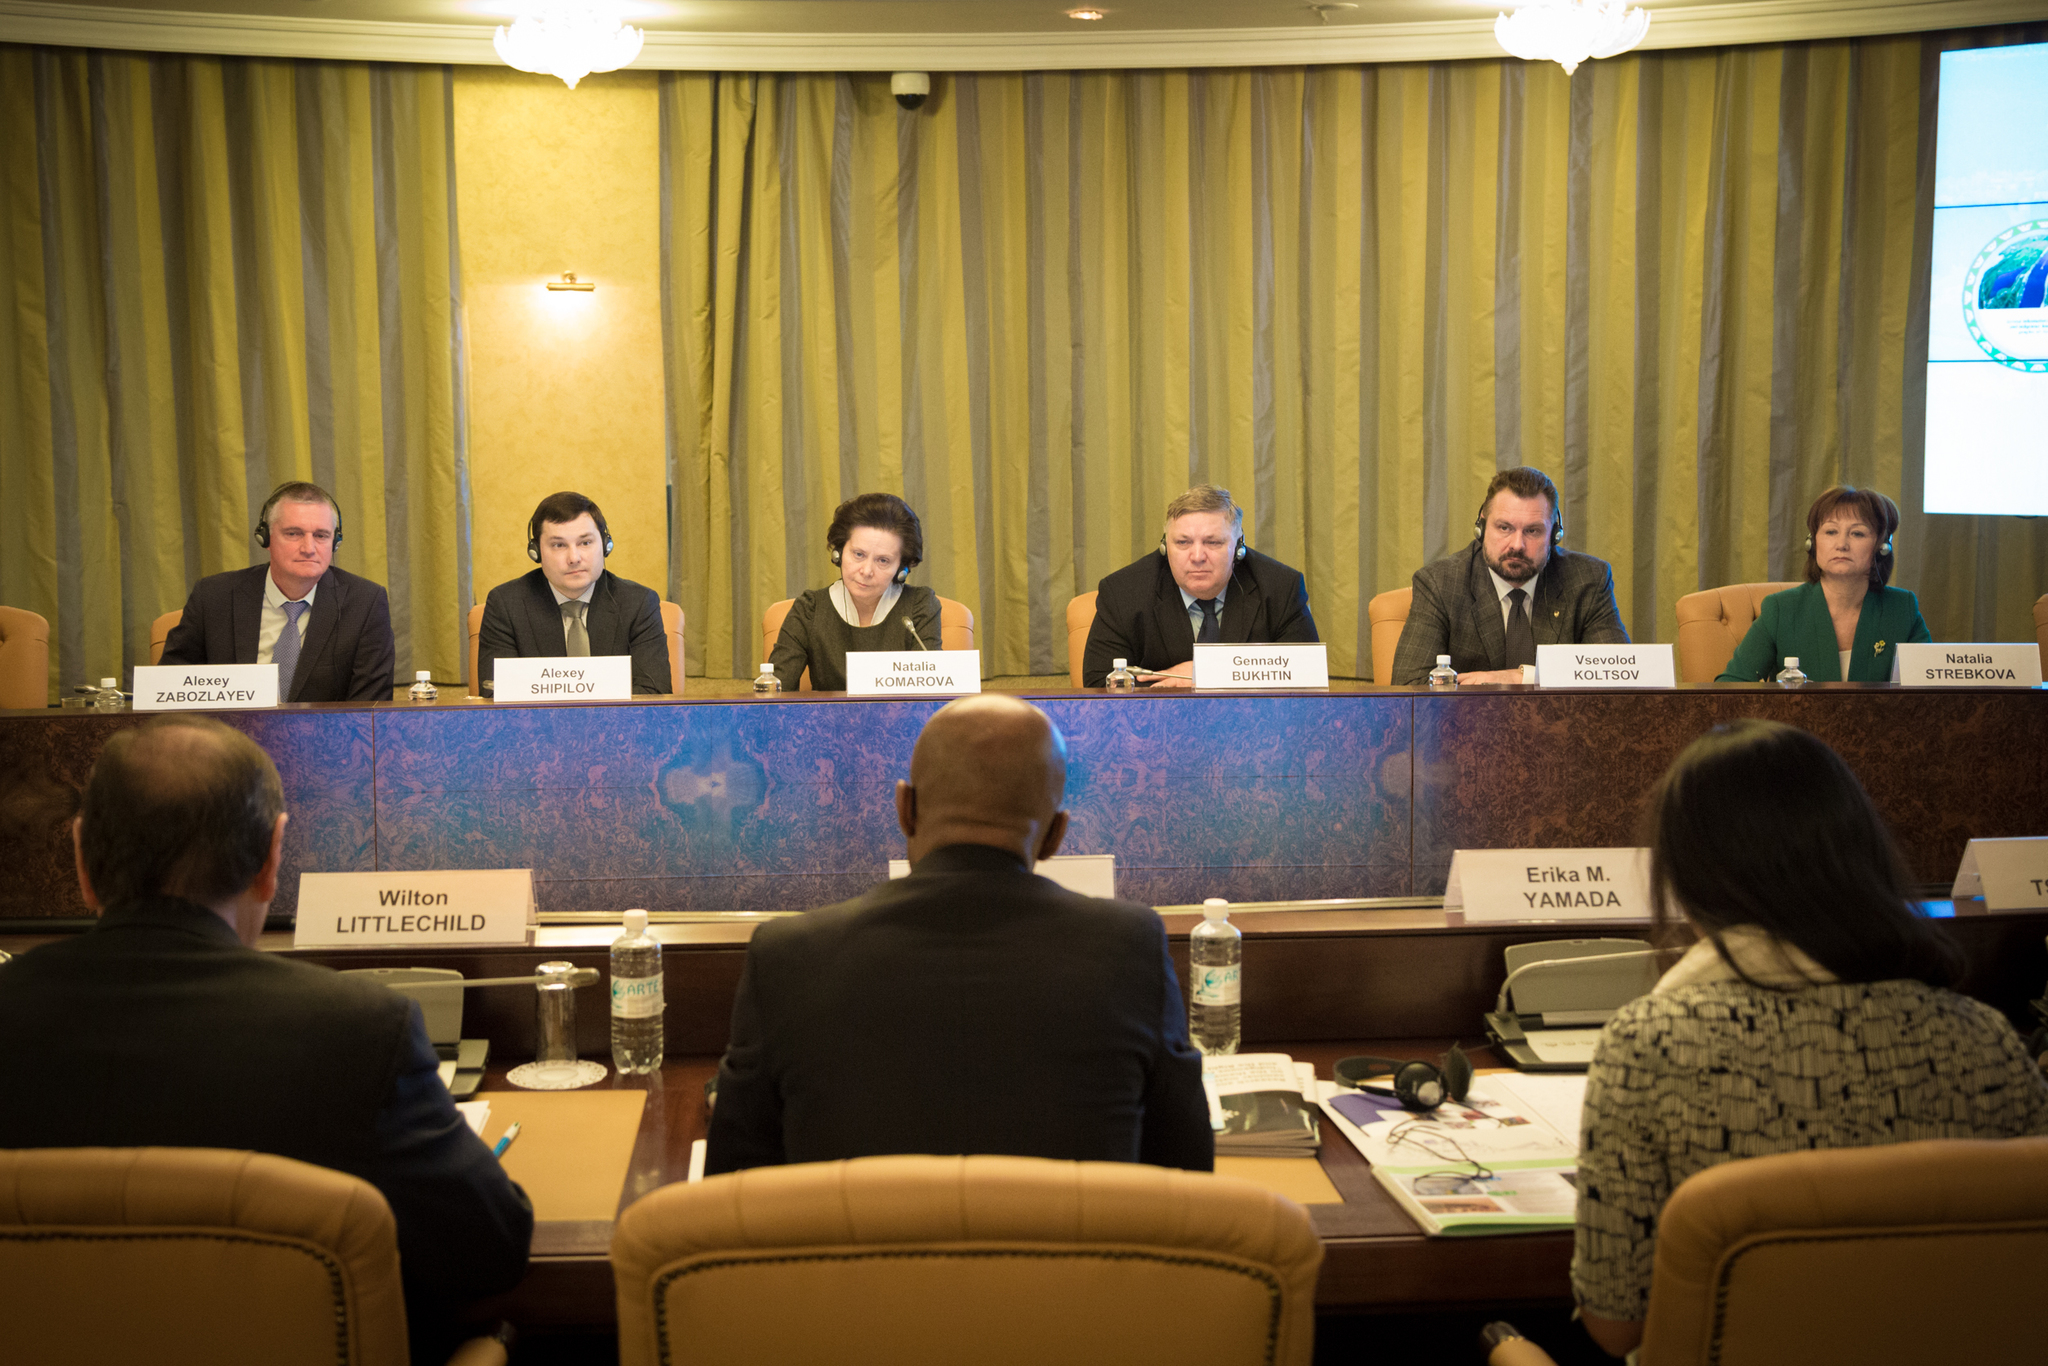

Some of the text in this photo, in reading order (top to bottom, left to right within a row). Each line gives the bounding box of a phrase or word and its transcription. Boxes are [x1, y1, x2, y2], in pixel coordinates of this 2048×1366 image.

[1232, 655, 1290, 668] Gennady
[1575, 655, 1636, 665] Vsevolod
[1945, 653, 1993, 664] Natalia
[892, 661, 936, 672] Natalia
[540, 668, 585, 680] Alexey
[1232, 670, 1292, 681] BUKHTIN
[1573, 669, 1640, 681] KOLTSOV
[1925, 668, 2016, 680] STREBKOVA
[182, 675, 230, 688] Alexey
[875, 676, 954, 687] KOMAROVA
[530, 682, 595, 695] SHIPILOV
[156, 690, 256, 703] ZABOZLAYEV
[1526, 866, 1611, 883] Erika M.
[2030, 877, 2048, 896] T
[378, 889, 449, 907] Wilton
[1523, 890, 1622, 909] YAMADA
[336, 914, 486, 933] LITTLECHILD
